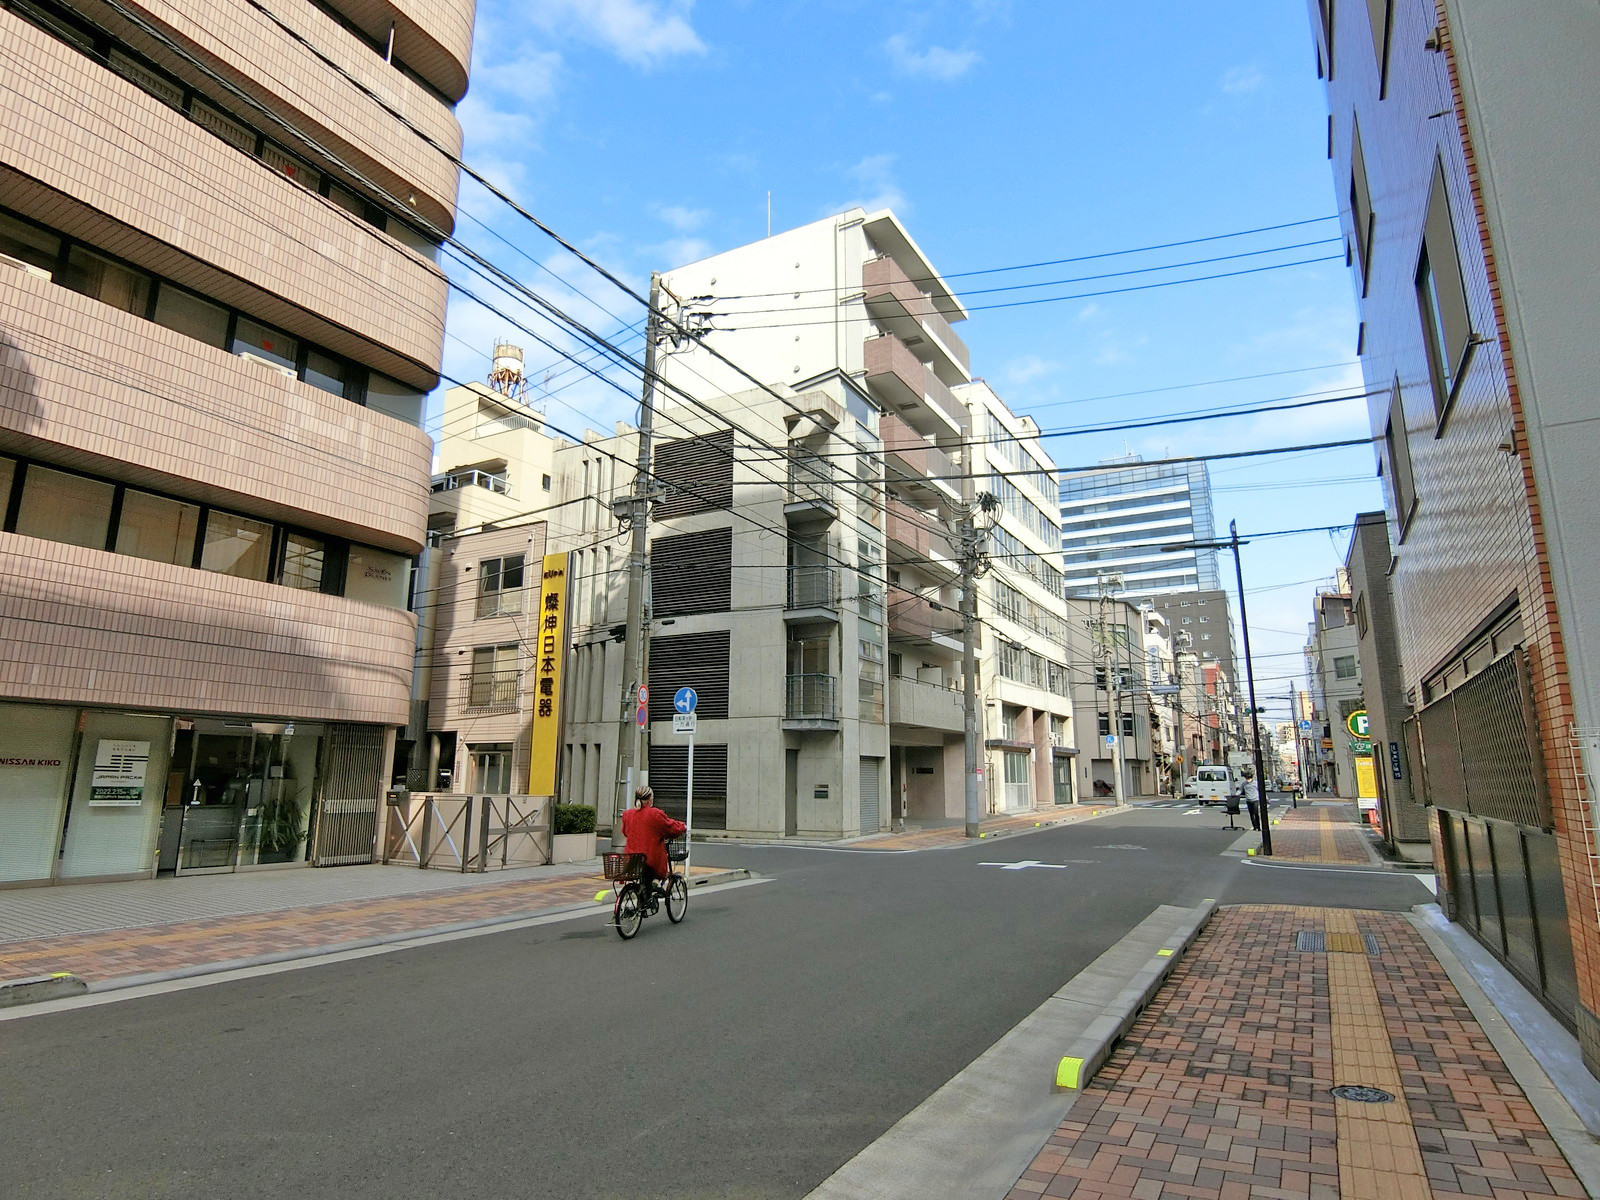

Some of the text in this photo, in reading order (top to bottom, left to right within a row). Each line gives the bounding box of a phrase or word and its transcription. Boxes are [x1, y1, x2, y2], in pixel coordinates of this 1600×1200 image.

[538, 592, 559, 717] 燦坤日本電器
[0, 757, 36, 765] NISSAN
